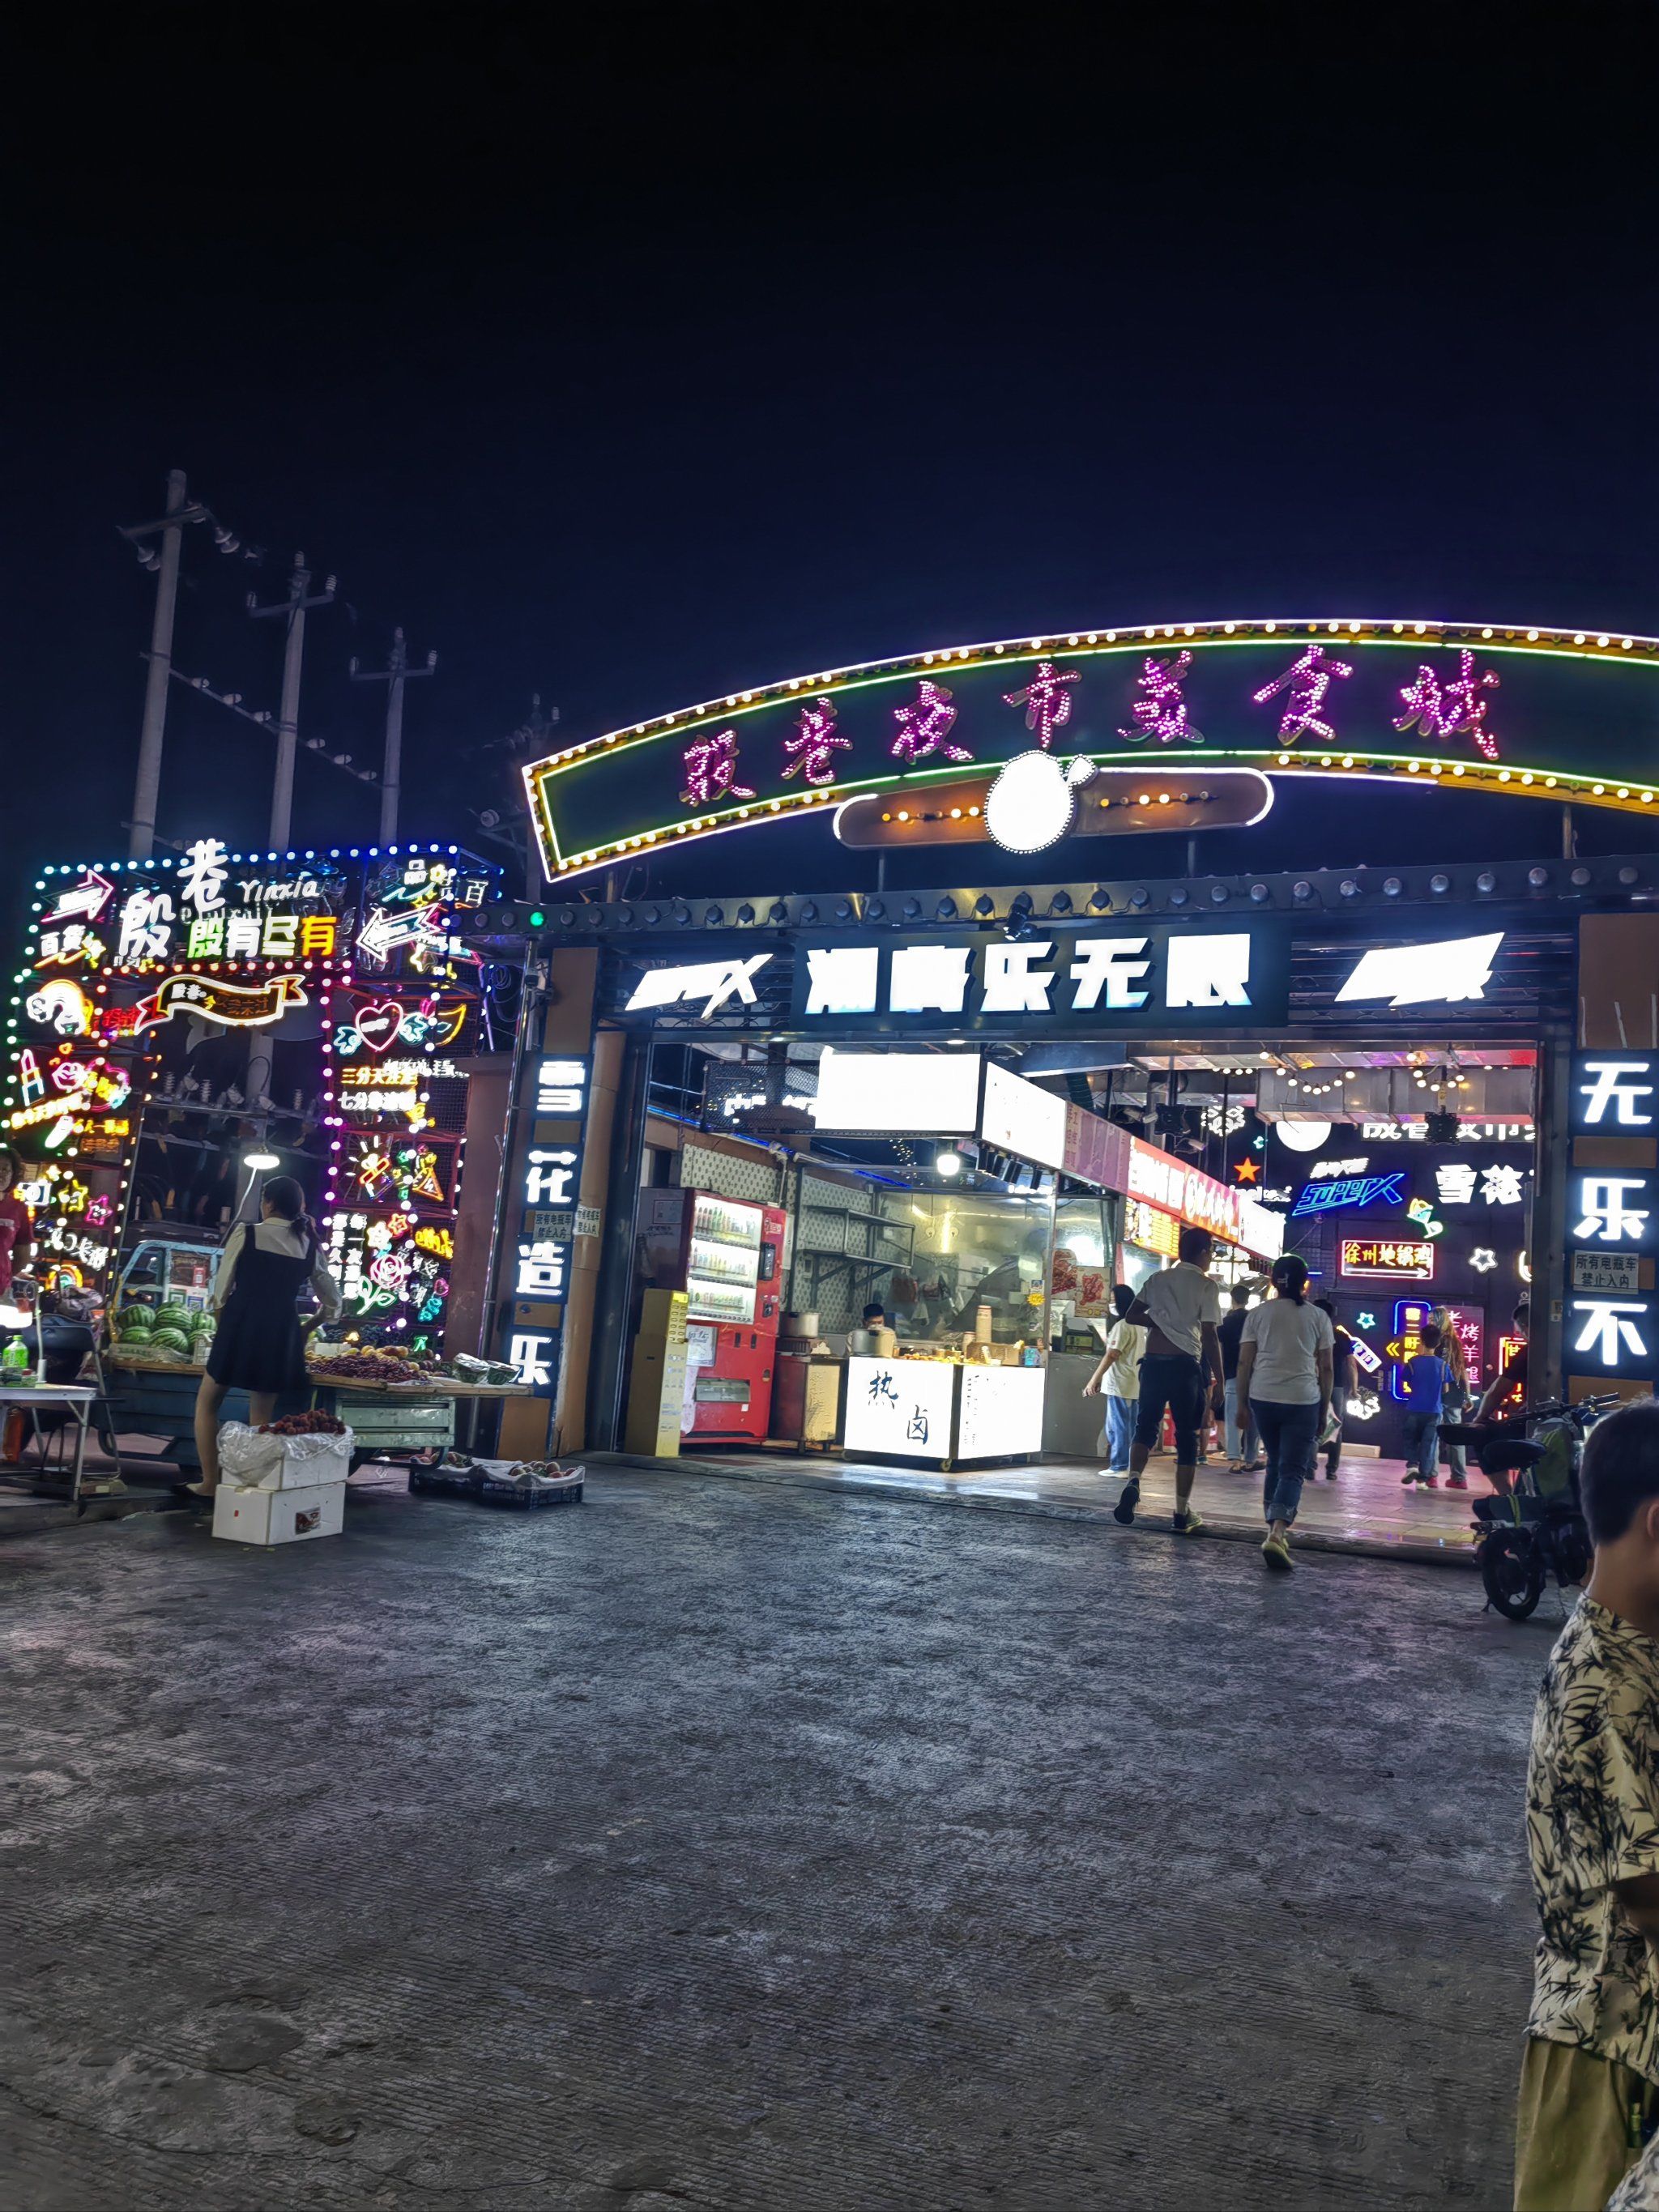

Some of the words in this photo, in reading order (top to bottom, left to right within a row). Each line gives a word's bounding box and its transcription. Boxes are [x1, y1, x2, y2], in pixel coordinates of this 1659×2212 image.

[679, 645, 1500, 807] 殷巷夜市美食城
[119, 838, 228, 958] 殷巷
[186, 915, 337, 958] 殷有尽有
[510, 1060, 586, 1386] 雪花造乐
[1345, 1242, 1431, 1268] 徐州地锅鸡
[1576, 1255, 1637, 1271] 所有电瓶车
[1581, 1272, 1630, 1288] 禁止入内
[868, 1370, 929, 1445] 热卤
